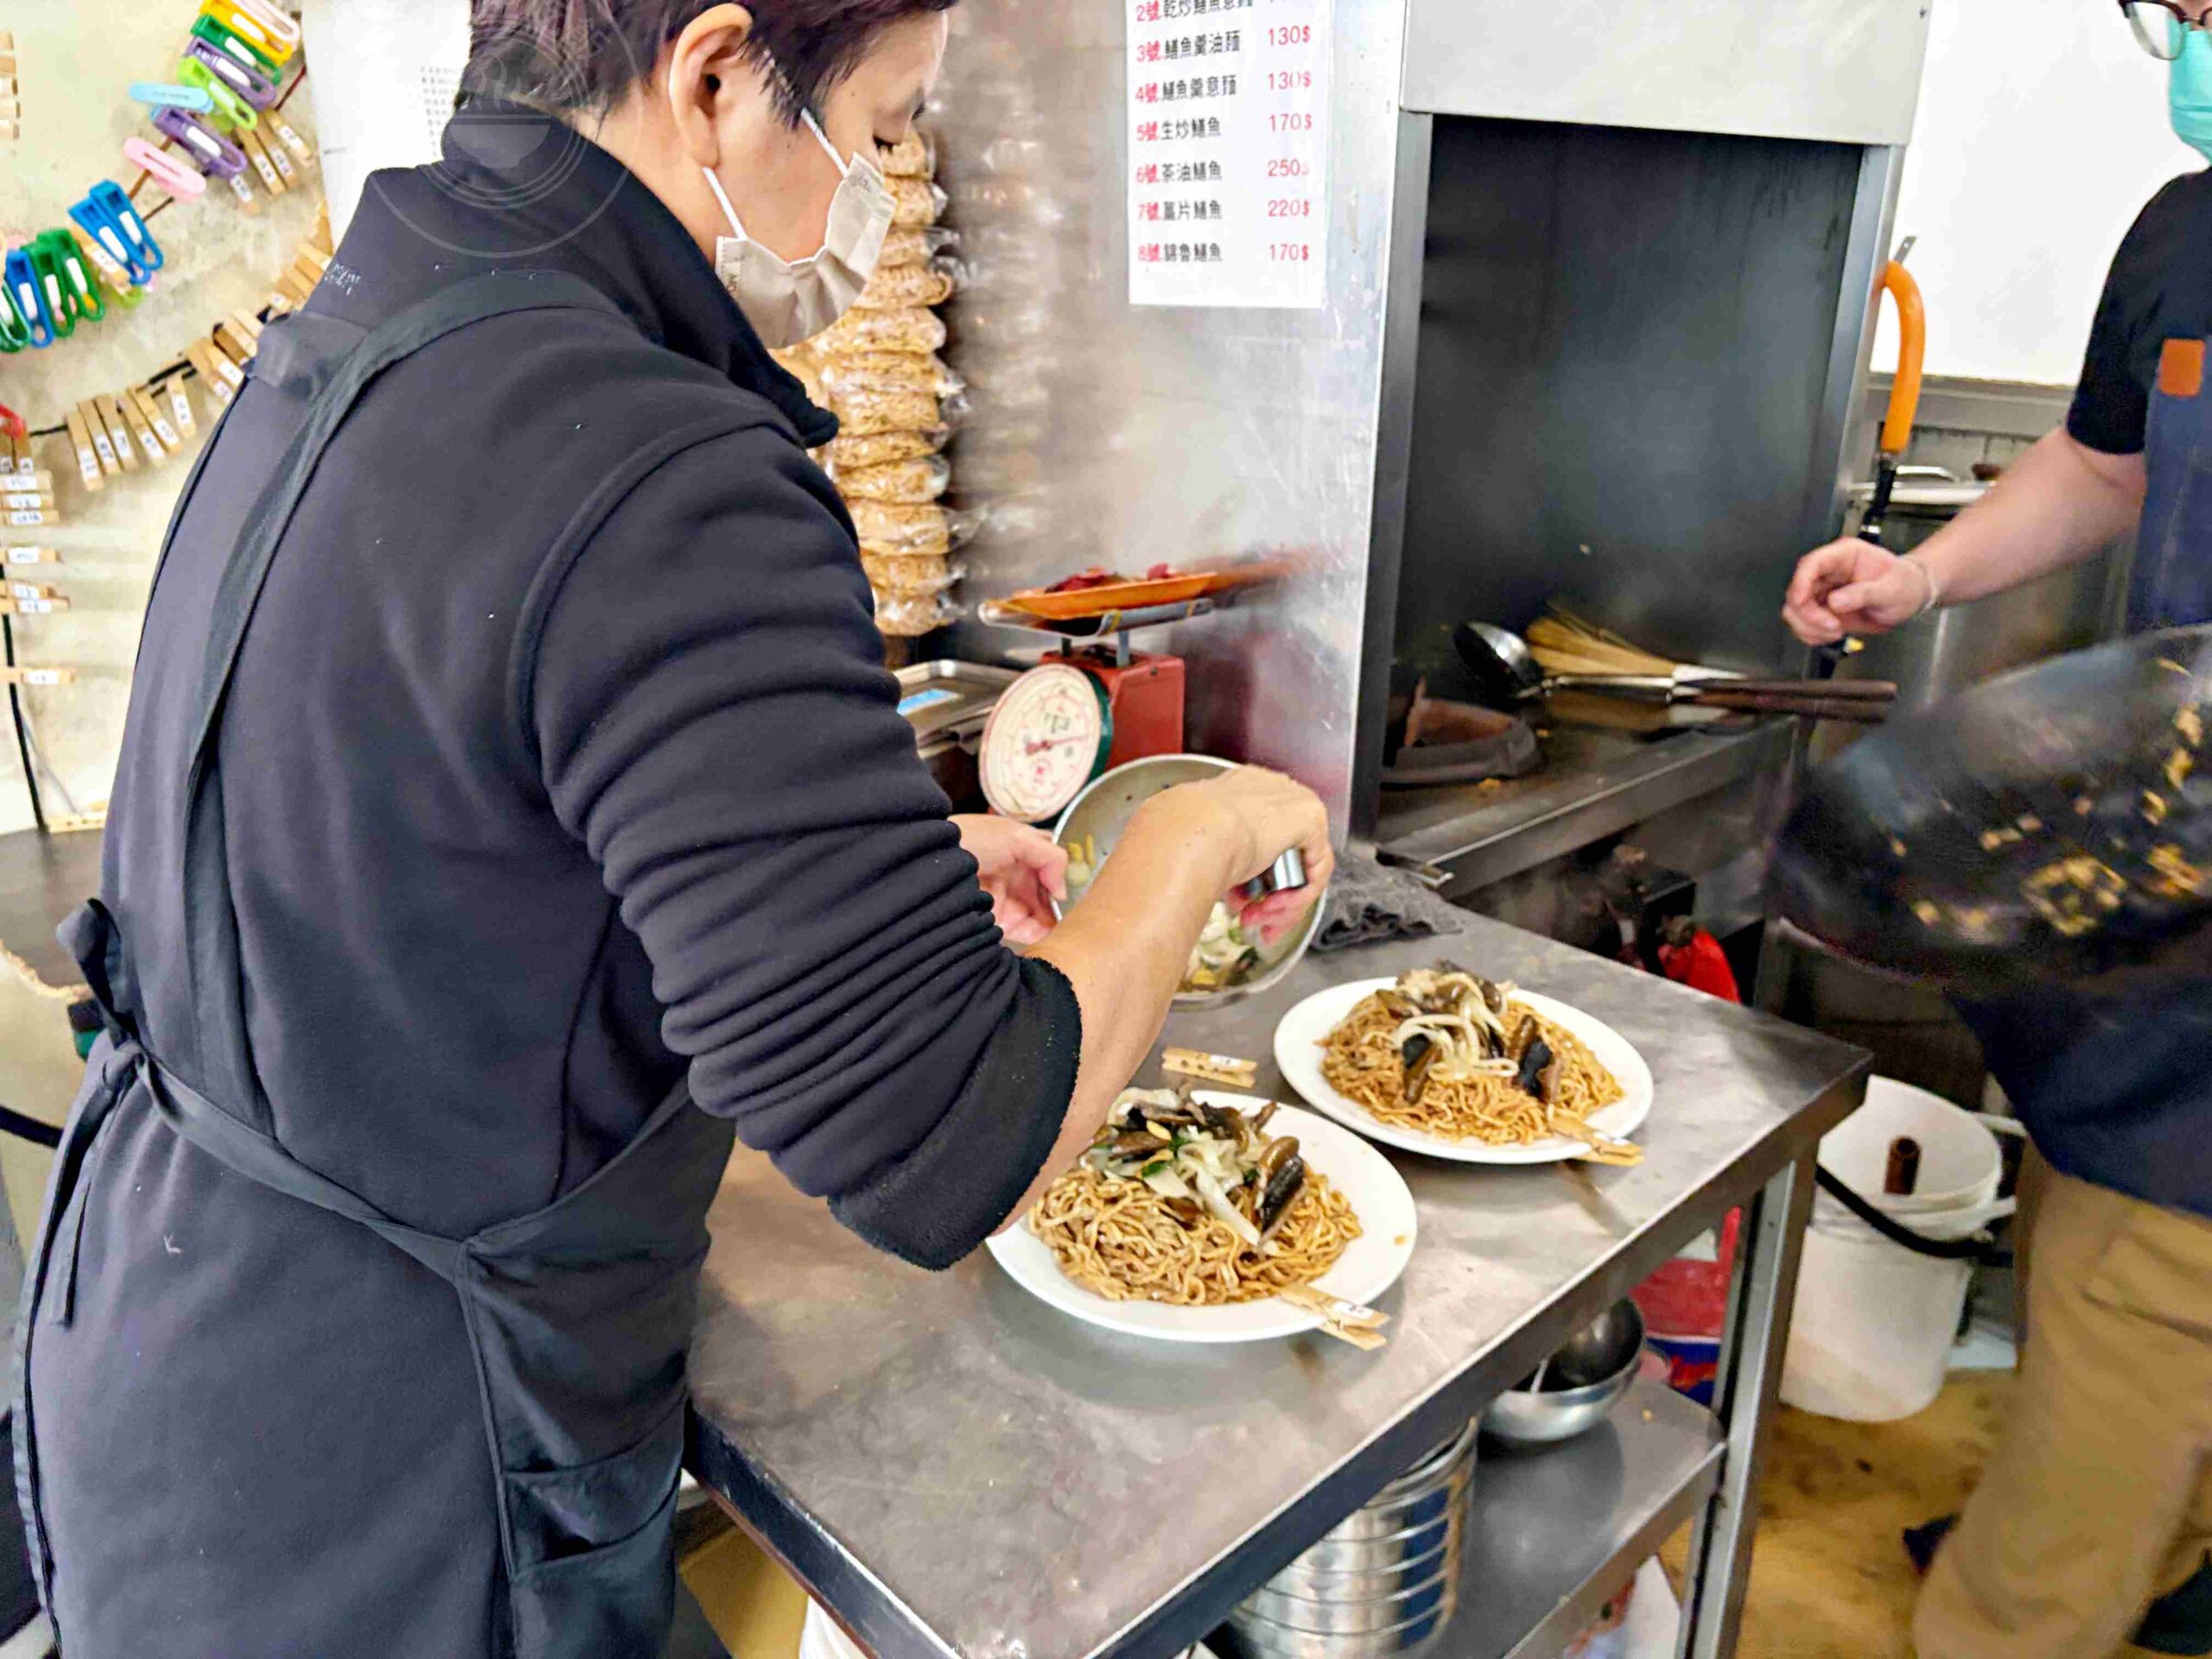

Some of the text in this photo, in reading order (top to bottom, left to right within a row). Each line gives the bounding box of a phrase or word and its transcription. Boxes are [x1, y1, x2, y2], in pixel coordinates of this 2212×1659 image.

[1268, 24, 1311, 47] 130$
[1268, 71, 1312, 92] 130$
[1269, 113, 1313, 132] 170$
[1268, 200, 1310, 217] 220$
[1269, 244, 1309, 261] 170$
